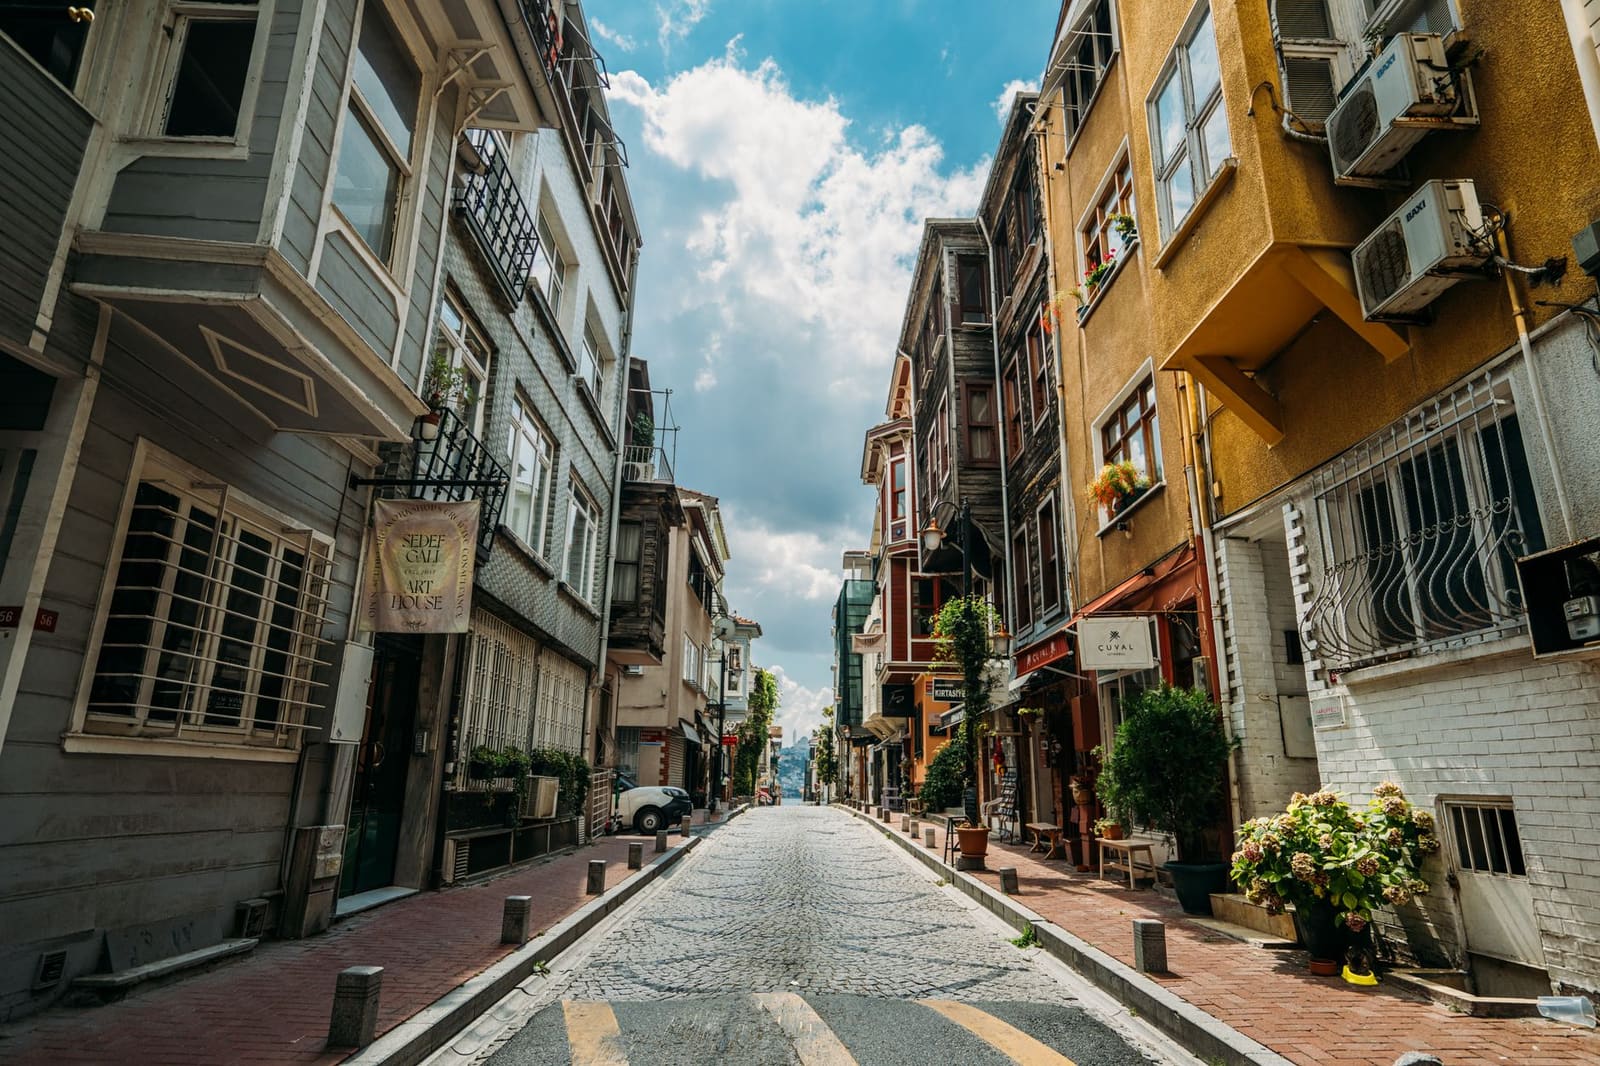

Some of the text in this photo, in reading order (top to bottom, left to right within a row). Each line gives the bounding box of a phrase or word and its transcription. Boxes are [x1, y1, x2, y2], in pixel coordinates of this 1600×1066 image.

[1376, 53, 1396, 79] BAXI
[1405, 200, 1426, 223] BAXI
[402, 534, 446, 548] SEDEF
[406, 580, 433, 594] ART
[391, 595, 443, 610] HOUSE
[40, 614, 53, 626] 56
